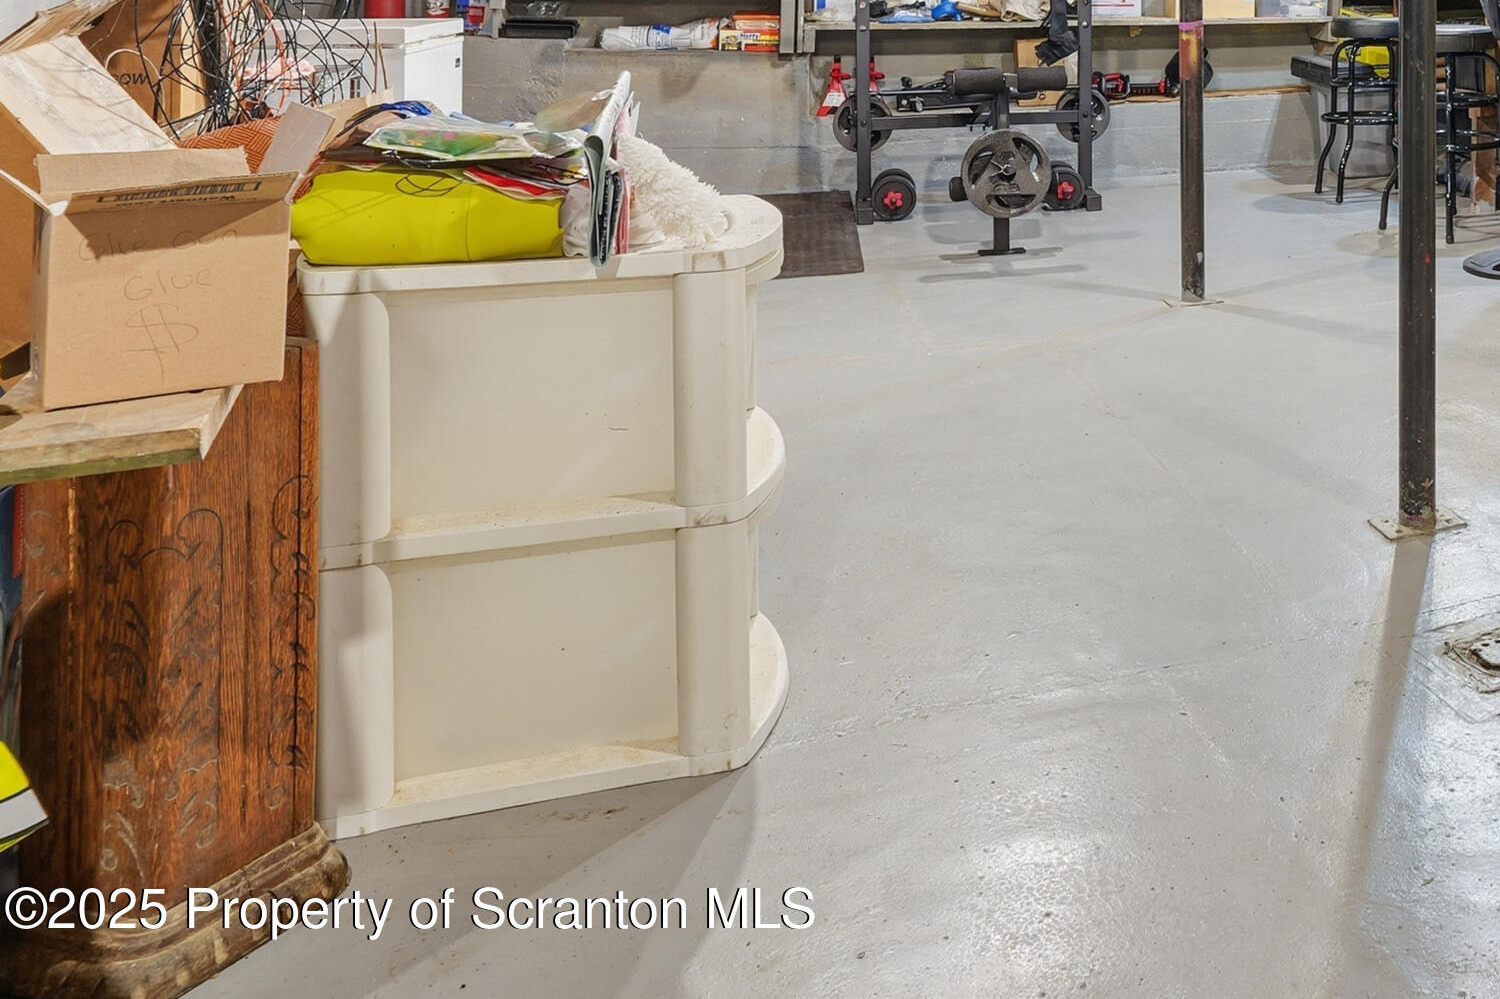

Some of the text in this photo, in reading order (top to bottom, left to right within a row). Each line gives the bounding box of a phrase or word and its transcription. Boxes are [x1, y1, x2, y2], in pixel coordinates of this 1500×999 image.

[78, 228, 239, 262] Glue Gun
[123, 268, 212, 301] Glue
